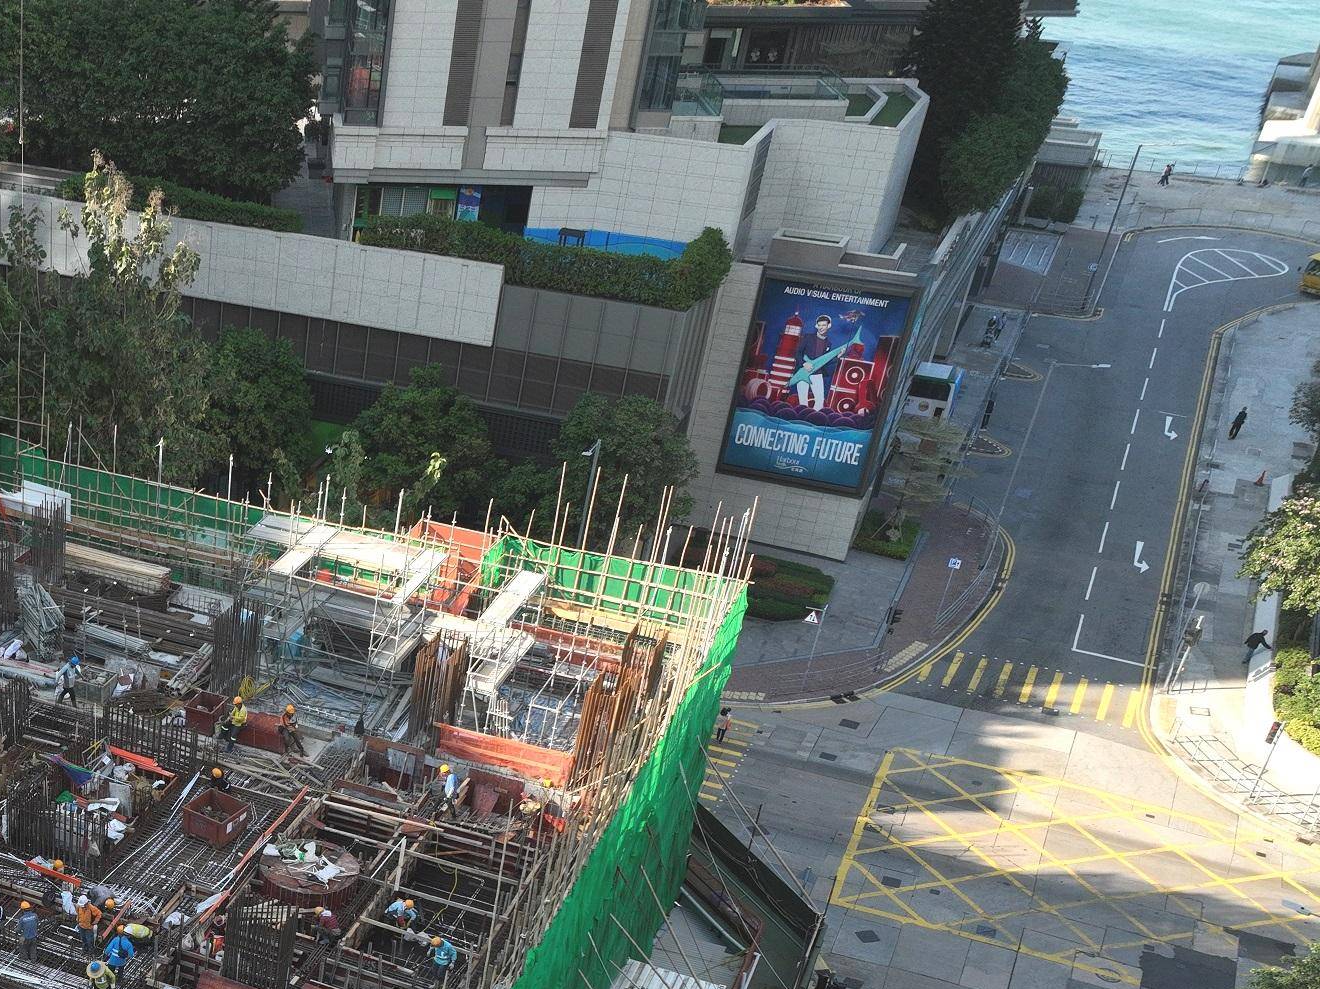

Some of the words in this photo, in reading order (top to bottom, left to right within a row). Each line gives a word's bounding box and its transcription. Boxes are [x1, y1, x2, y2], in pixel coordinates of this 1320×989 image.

[784, 286, 806, 296] AUDIO
[807, 289, 830, 300] VISUAL
[831, 292, 890, 308] ENTERTAINMENT
[734, 423, 810, 456] CONNECTING
[811, 436, 863, 465] FUTURE
